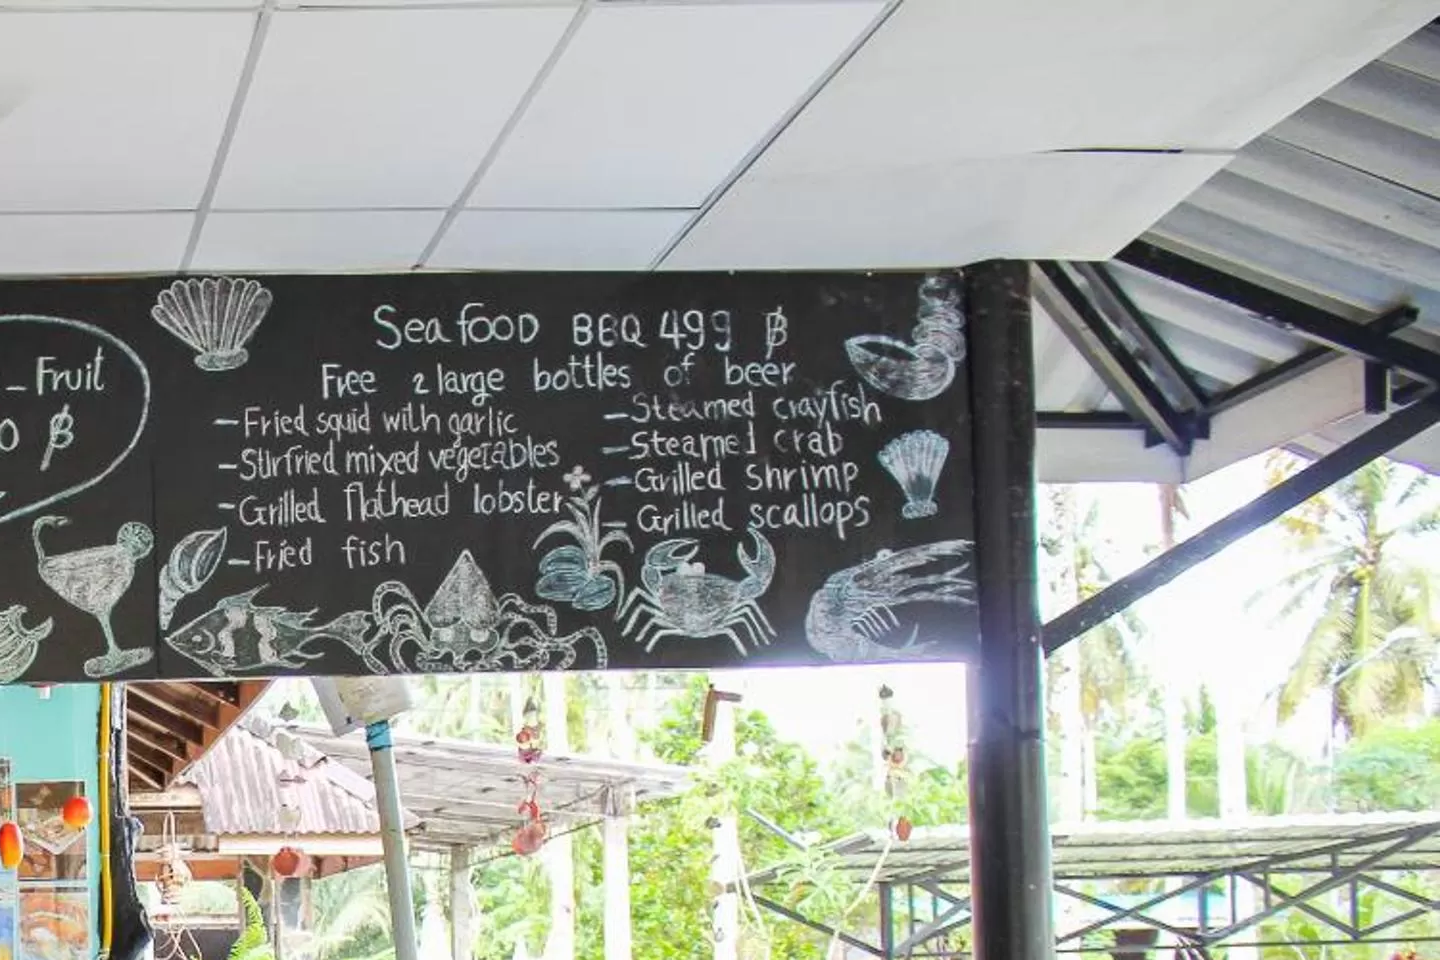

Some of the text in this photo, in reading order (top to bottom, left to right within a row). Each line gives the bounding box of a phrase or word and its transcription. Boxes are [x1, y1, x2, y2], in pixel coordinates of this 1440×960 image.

[572, 312, 647, 349] BBQ
[660, 309, 732, 352] 499
[35, 346, 106, 396] Fruit
[321, 352, 797, 407] Free 2 large bottles of beer
[243, 402, 519, 445] Fried squid with garlic
[630, 379, 882, 428] Steamed crayfish
[345, 441, 419, 478] mixed
[428, 435, 560, 482] vegetables
[629, 421, 845, 462] Steamed crab
[634, 460, 726, 496] Grilled
[238, 478, 564, 526] Grilled flathead lobster
[636, 492, 871, 541] Grilled scallops
[254, 532, 406, 573] Fried fish
